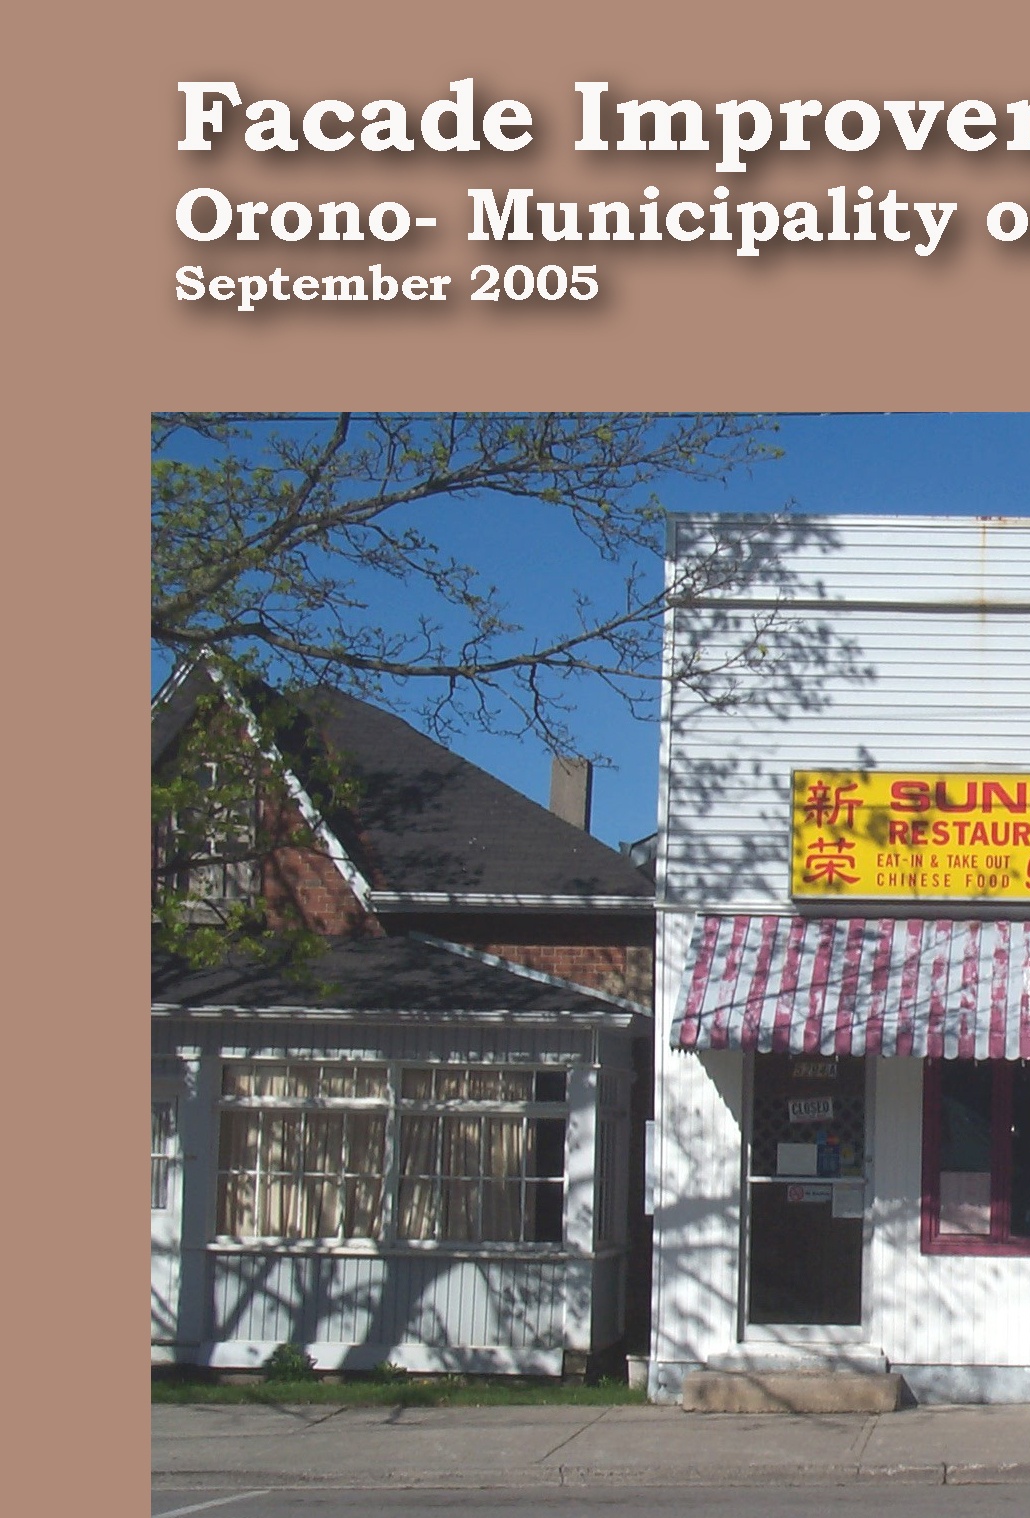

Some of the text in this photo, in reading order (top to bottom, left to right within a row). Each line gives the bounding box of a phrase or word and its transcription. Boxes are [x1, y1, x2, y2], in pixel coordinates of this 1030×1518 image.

[877, 854, 1010, 869] EAT-IN & TAKE OUT
[877, 873, 1010, 888] CHINESE FOOD
[792, 1100, 829, 1115] CLOSED
